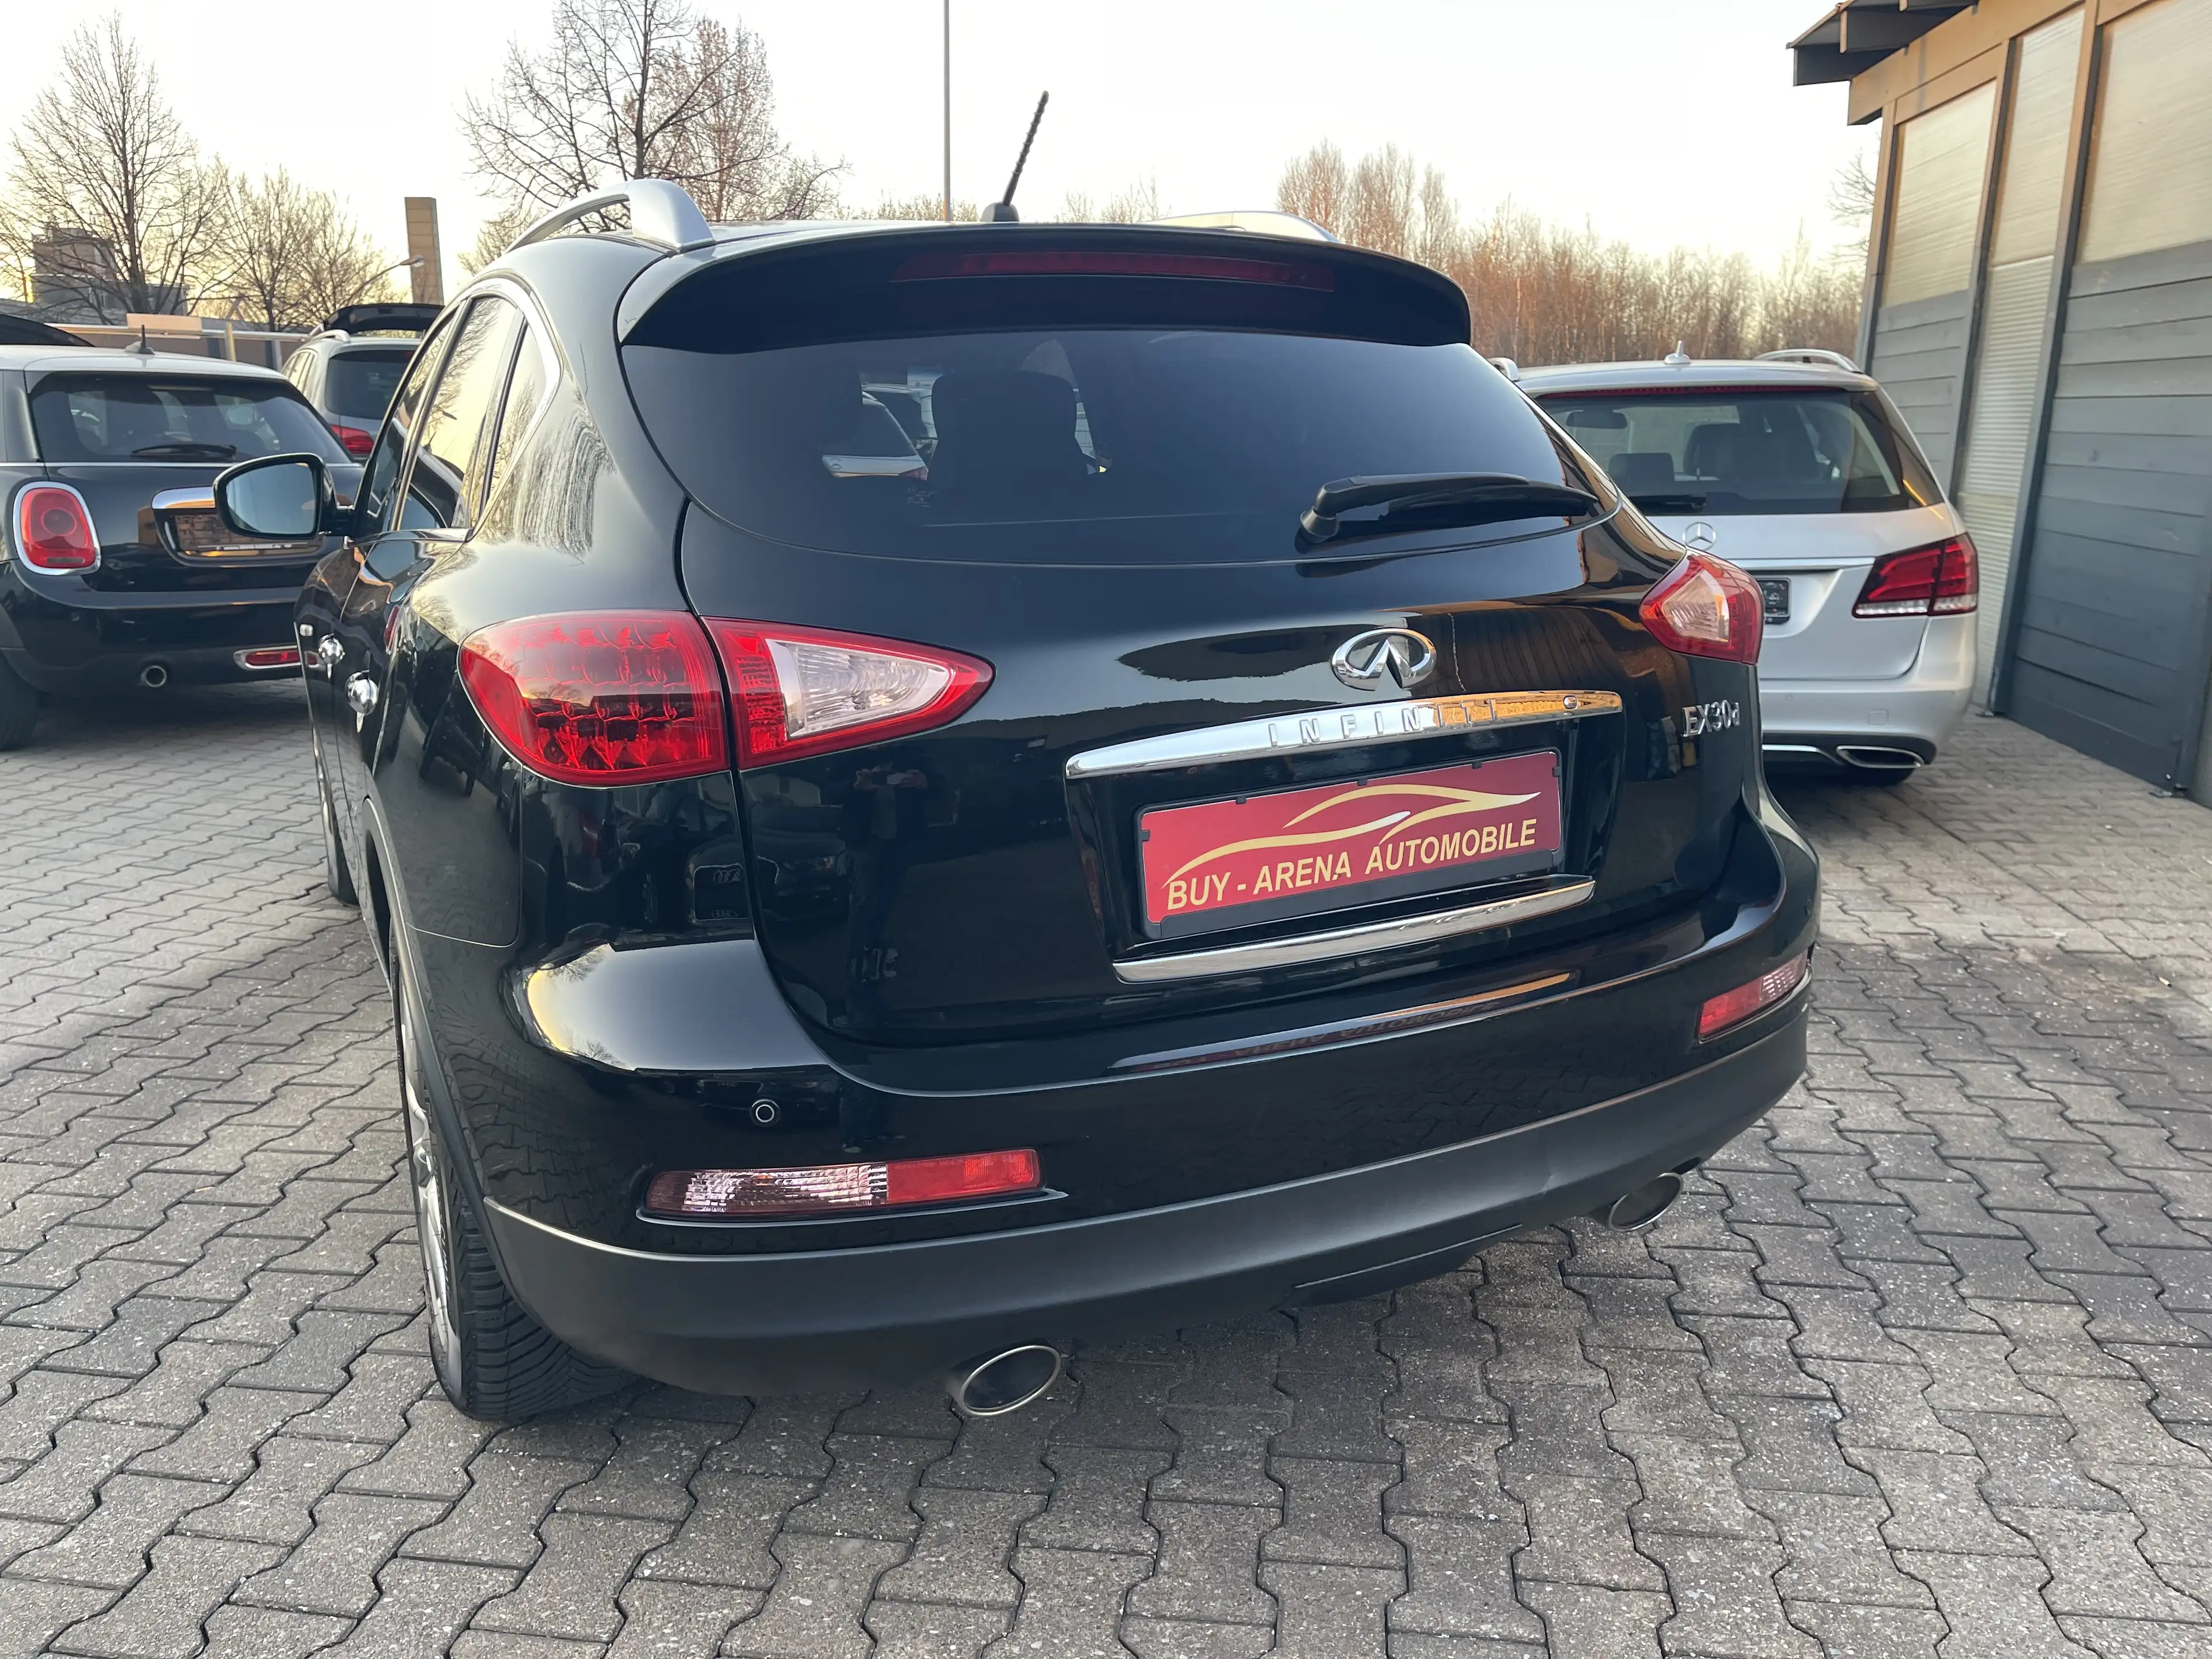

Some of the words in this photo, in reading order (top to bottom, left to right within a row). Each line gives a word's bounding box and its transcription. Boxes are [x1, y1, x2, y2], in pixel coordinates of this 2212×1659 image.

[1268, 698, 1498, 747] INFINITI
[1681, 699, 1740, 737] EX30d
[1167, 871, 1232, 910] BUY
[1253, 851, 1352, 895] ARENA
[1365, 818, 1537, 874] AUTOMOBILE
